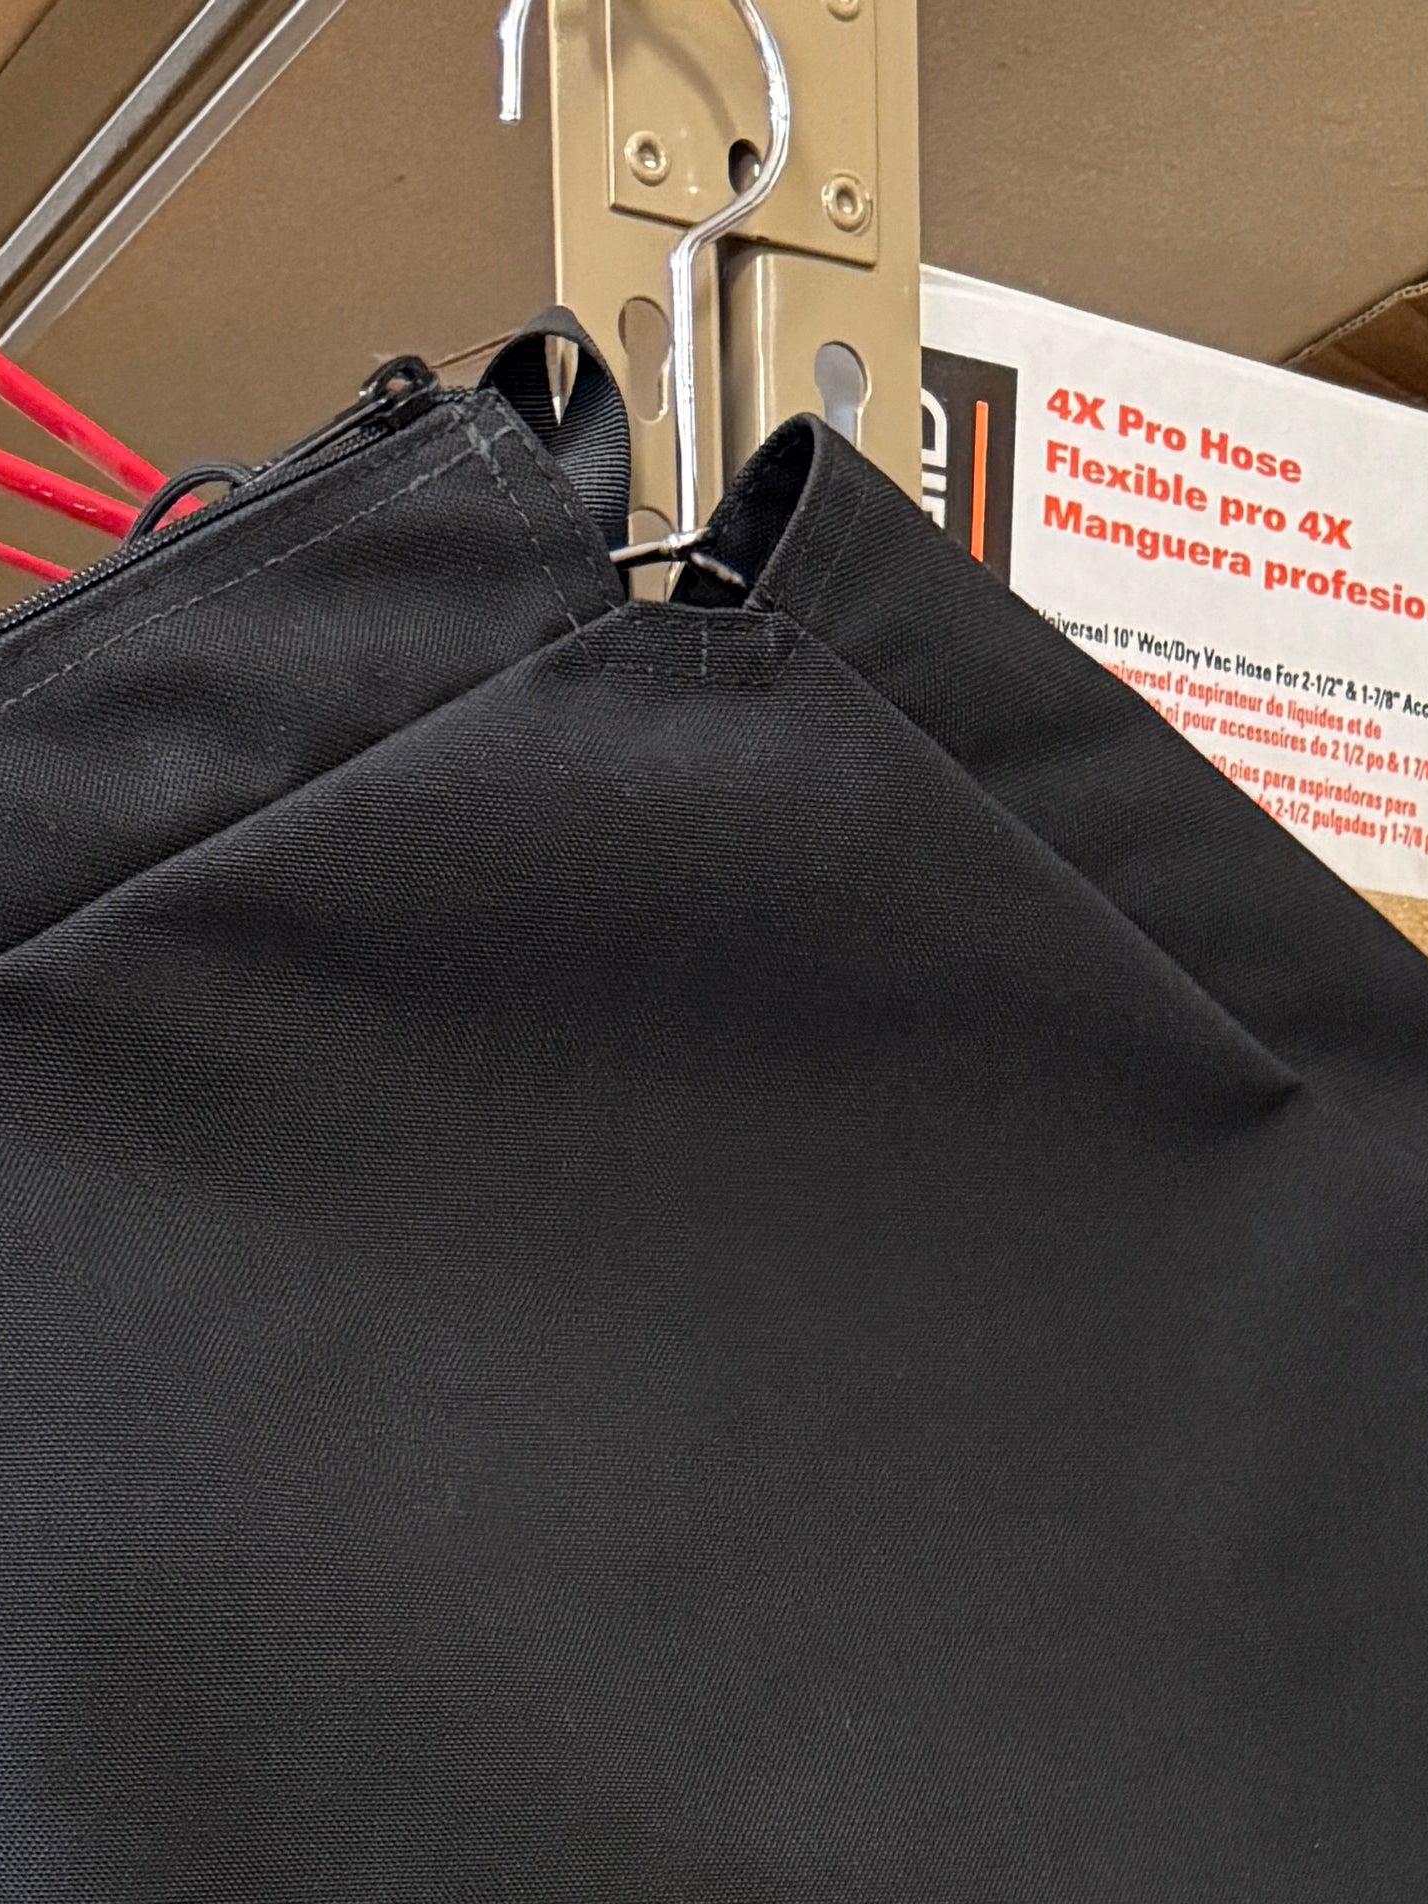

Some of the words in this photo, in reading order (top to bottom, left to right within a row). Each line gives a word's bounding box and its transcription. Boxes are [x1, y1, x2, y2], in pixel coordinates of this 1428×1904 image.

[1047, 388, 1106, 430] 4X
[1118, 405, 1186, 451] Pro
[1200, 428, 1302, 483] Hose
[1046, 440, 1208, 512] Flexible
[1220, 496, 1286, 533] pro
[1298, 511, 1352, 549] 4X
[1043, 494, 1251, 577] Manguera
[1138, 632, 1201, 670] Wet/Dry
[1204, 647, 1231, 672] Vac
[1236, 655, 1272, 682] Hose
[1276, 664, 1299, 688] For
[1346, 681, 1357, 701] &
[1175, 676, 1262, 713] d'aspirateur
[1266, 696, 1284, 718] de
[1288, 701, 1344, 731] liquides
[1348, 718, 1362, 737] et
[1365, 720, 1382, 740] de
[1183, 710, 1215, 732] pour
[1219, 714, 1307, 753] accessoires
[1311, 736, 1328, 757] de
[1331, 740, 1340, 761] 2
[1344, 742, 1363, 765] 1/2
[1367, 753, 1383, 773] po
[1387, 752, 1399, 773] &
[1403, 757, 1410, 777] 1
[1263, 768, 1295, 791] para
[1299, 778, 1382, 810] aspiradoras
[1385, 796, 1417, 817] para
[1276, 798, 1310, 824] 2-1/2
[1313, 807, 1376, 837] pulgadas
[1379, 824, 1388, 844] y
[1392, 823, 1422, 848] 1-7/8
